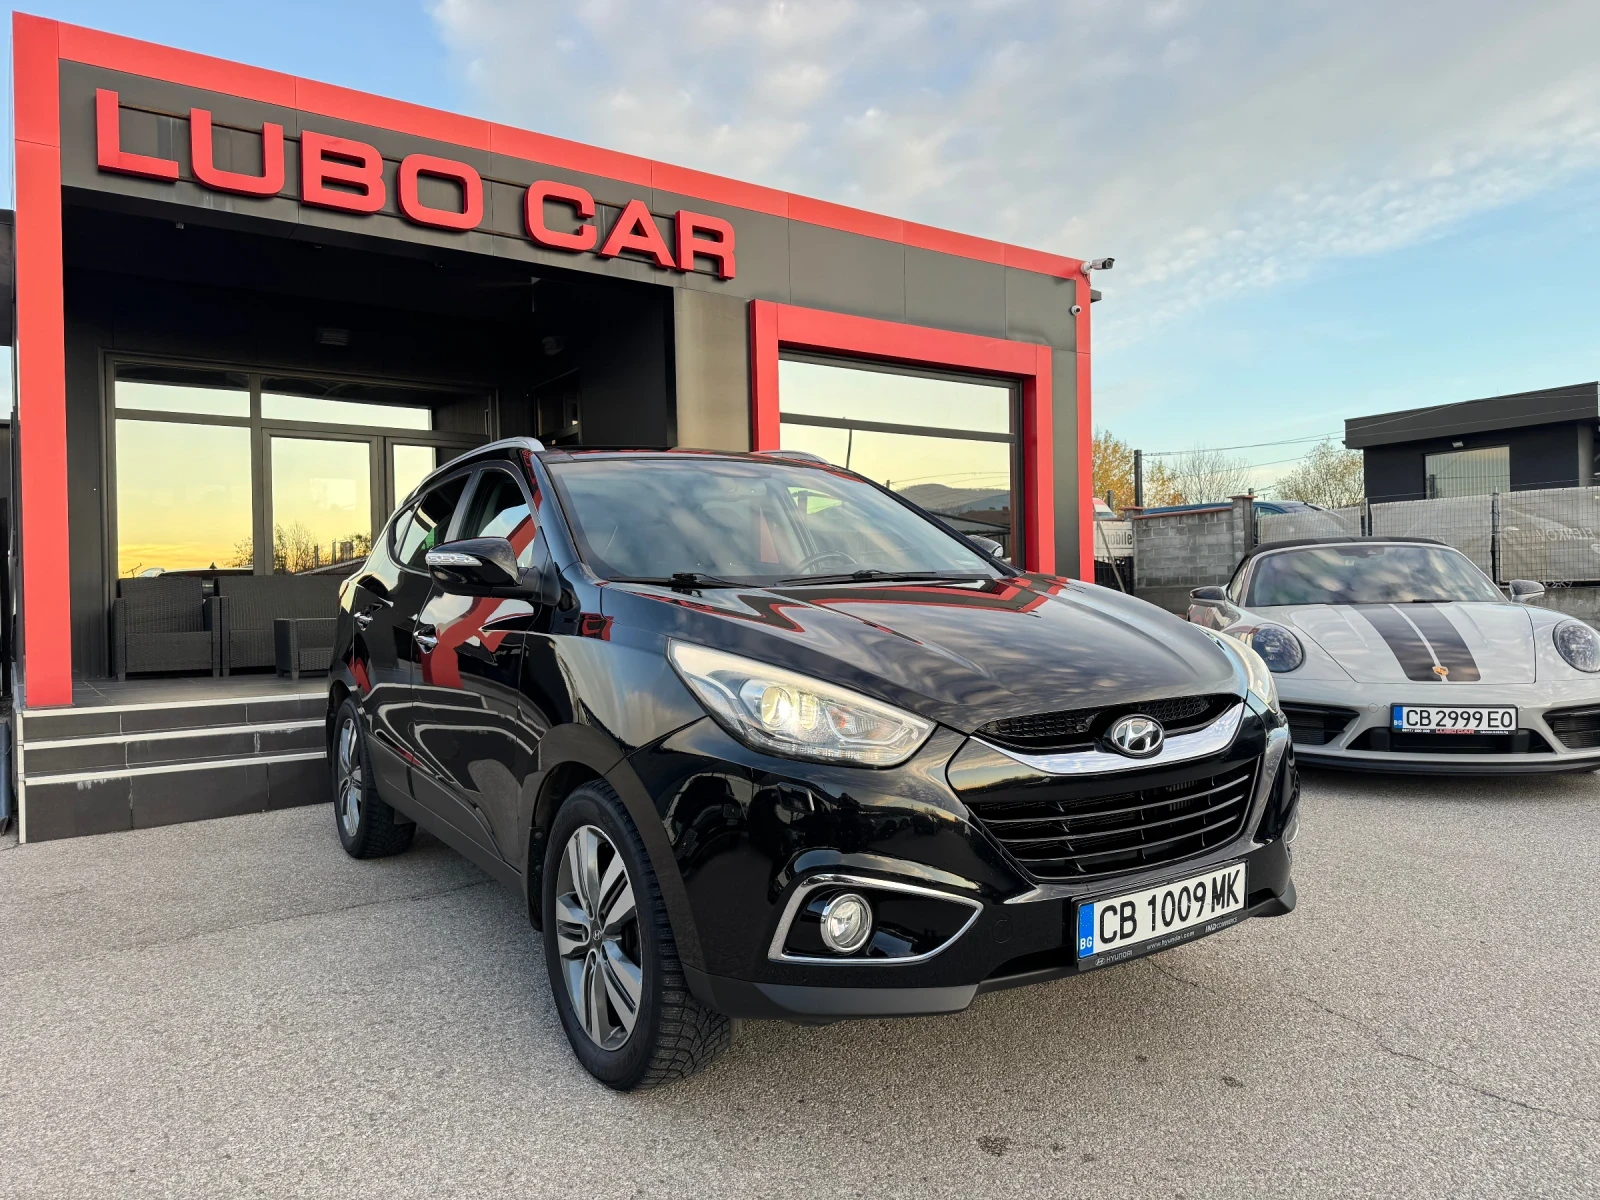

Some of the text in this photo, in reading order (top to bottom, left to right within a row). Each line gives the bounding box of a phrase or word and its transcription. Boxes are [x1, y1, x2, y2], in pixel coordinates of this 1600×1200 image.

[96, 88, 736, 280] LUBO CAR
[1406, 709, 1432, 727] CB
[1435, 710, 1483, 728] 2999
[1099, 869, 1241, 944] CB 1009 MK
[1079, 935, 1094, 950] BG
[1146, 931, 1195, 950] www.hyundai.com
[1106, 949, 1133, 964] HYUNDAI
